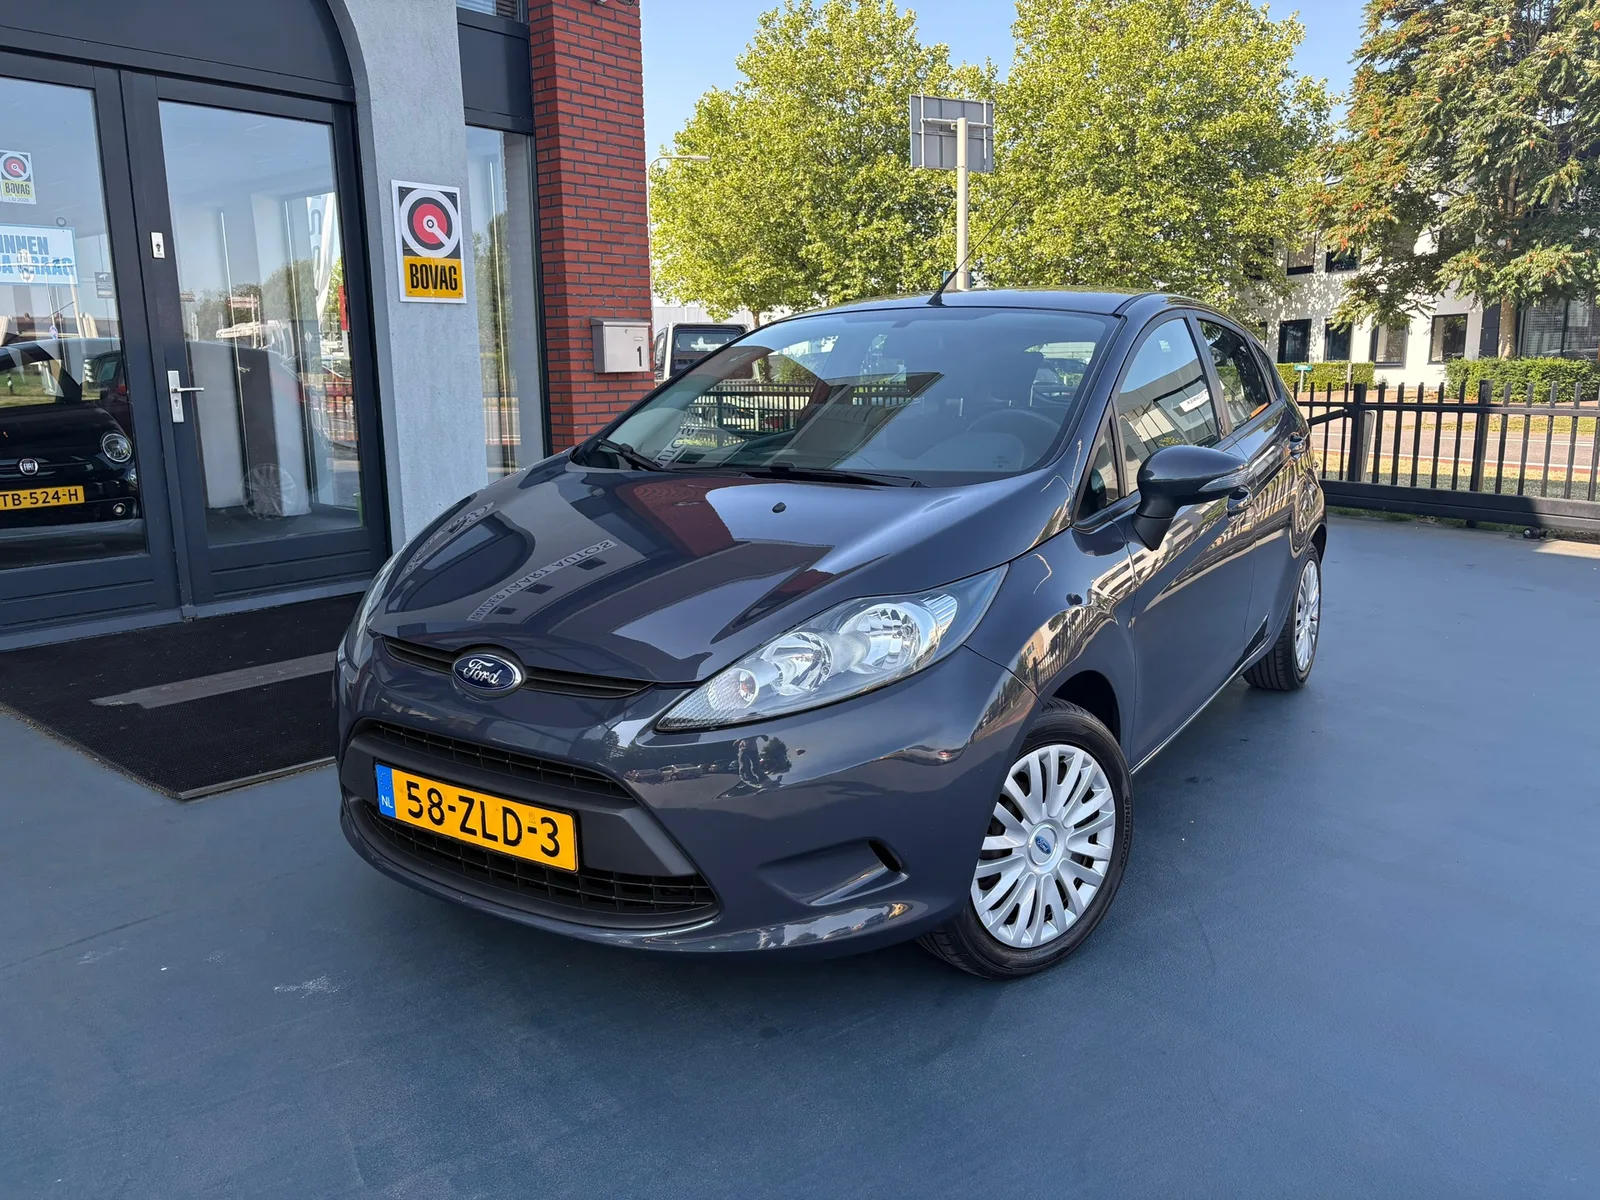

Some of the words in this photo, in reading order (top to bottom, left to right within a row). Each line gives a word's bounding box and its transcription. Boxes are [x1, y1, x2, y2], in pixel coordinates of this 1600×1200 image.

[5, 182, 31, 196] BOVAG
[409, 263, 459, 291] BOVAG
[636, 346, 643, 367] 1
[0, 488, 79, 508] TB-524-H
[459, 658, 502, 685] Ford
[381, 794, 394, 809] NL
[406, 780, 560, 858] 58-ZLD-3
